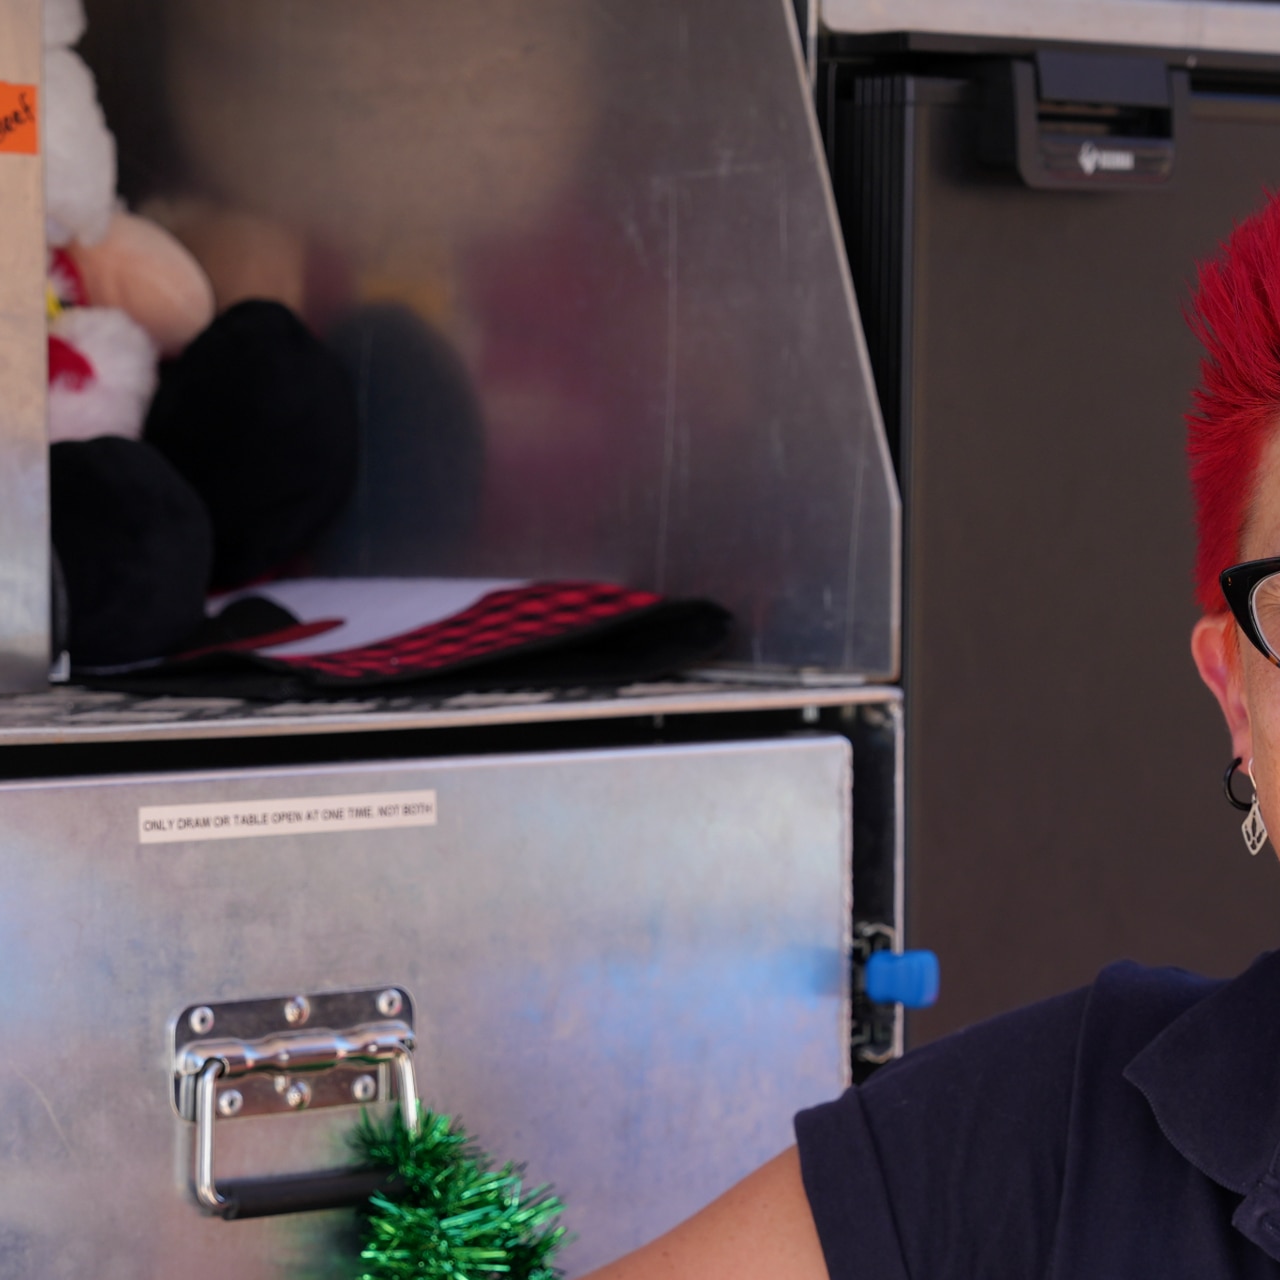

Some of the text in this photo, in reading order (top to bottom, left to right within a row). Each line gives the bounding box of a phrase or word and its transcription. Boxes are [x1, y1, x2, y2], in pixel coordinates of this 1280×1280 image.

[143, 818, 174, 832] ONLY
[177, 816, 210, 830] DRAW
[214, 814, 230, 828] OR
[234, 812, 269, 826] TABLE
[271, 810, 302, 824] OPEN
[305, 808, 319, 822] AT
[322, 806, 345, 821] ONE
[377, 803, 401, 818] NOT
[403, 802, 433, 817] BOTH
